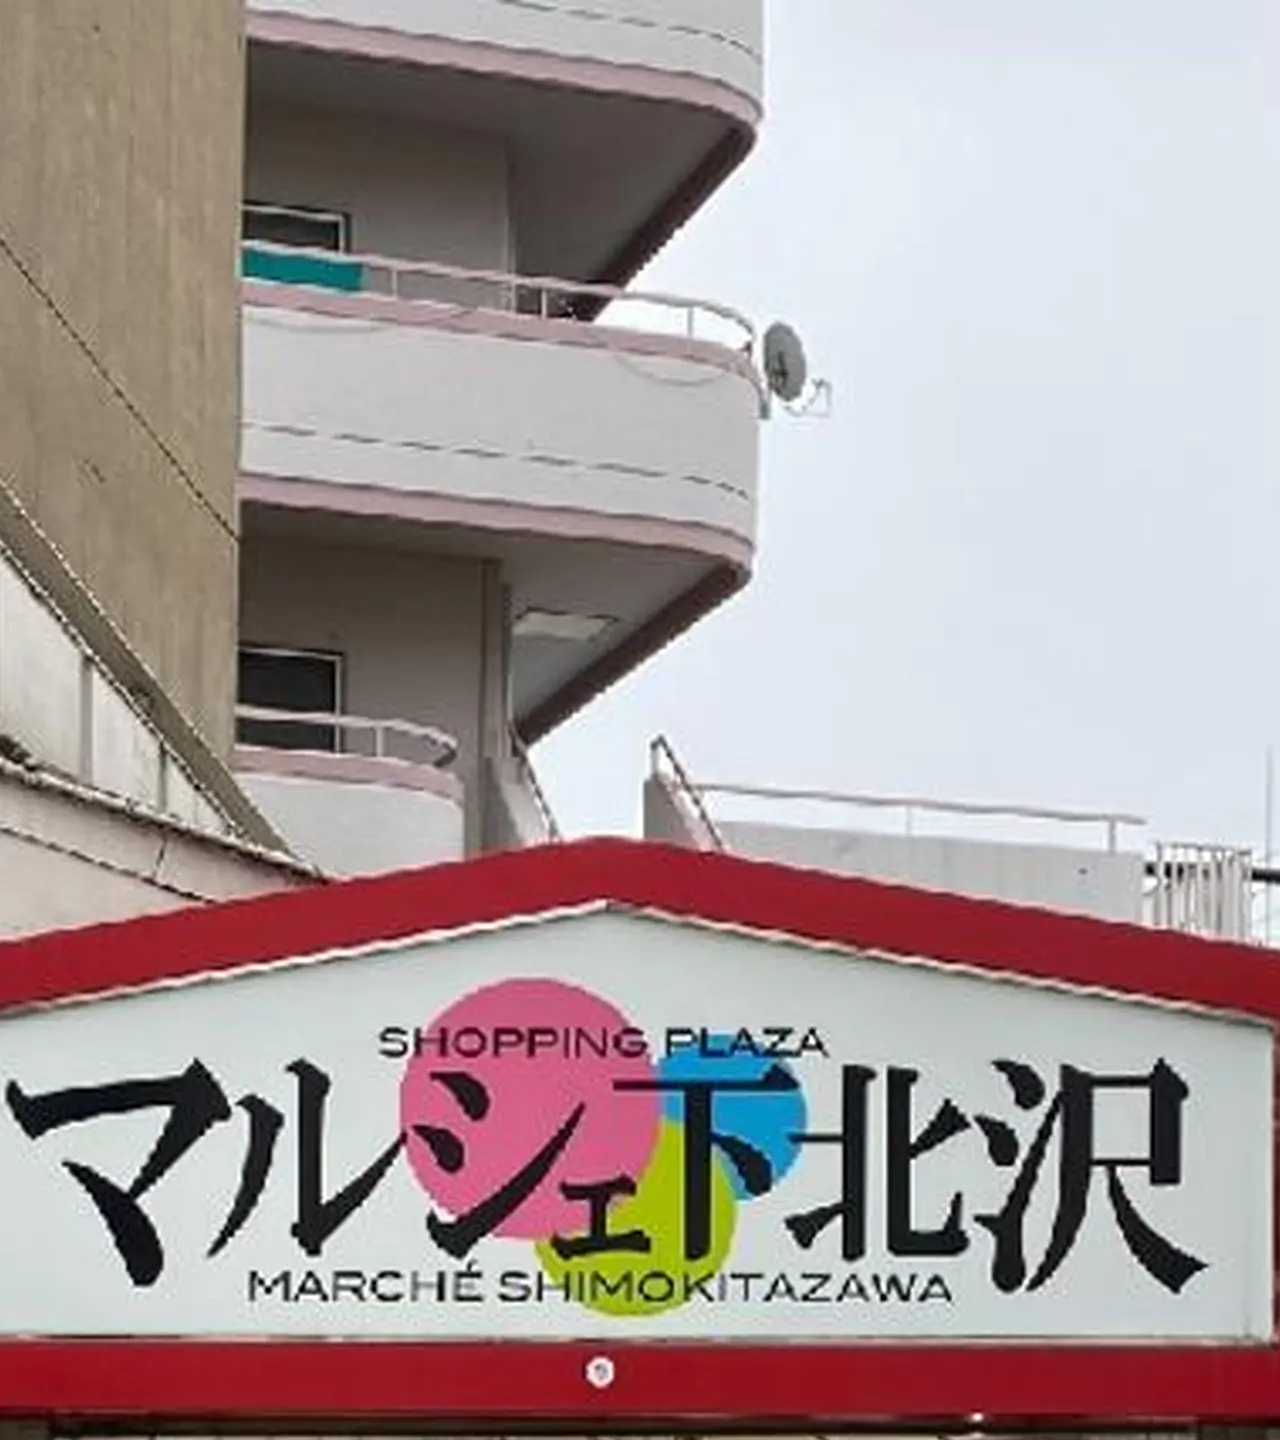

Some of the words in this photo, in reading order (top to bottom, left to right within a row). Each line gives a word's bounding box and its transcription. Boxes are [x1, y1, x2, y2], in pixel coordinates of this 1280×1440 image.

[377, 1026, 648, 1062] SHOPPING
[664, 1026, 829, 1062] PLAZA
[6, 1054, 1209, 1295] マルシェ下北沢
[247, 1261, 485, 1303] MARCHÉ
[496, 1271, 954, 1304] SHIMOKITAZAWA
